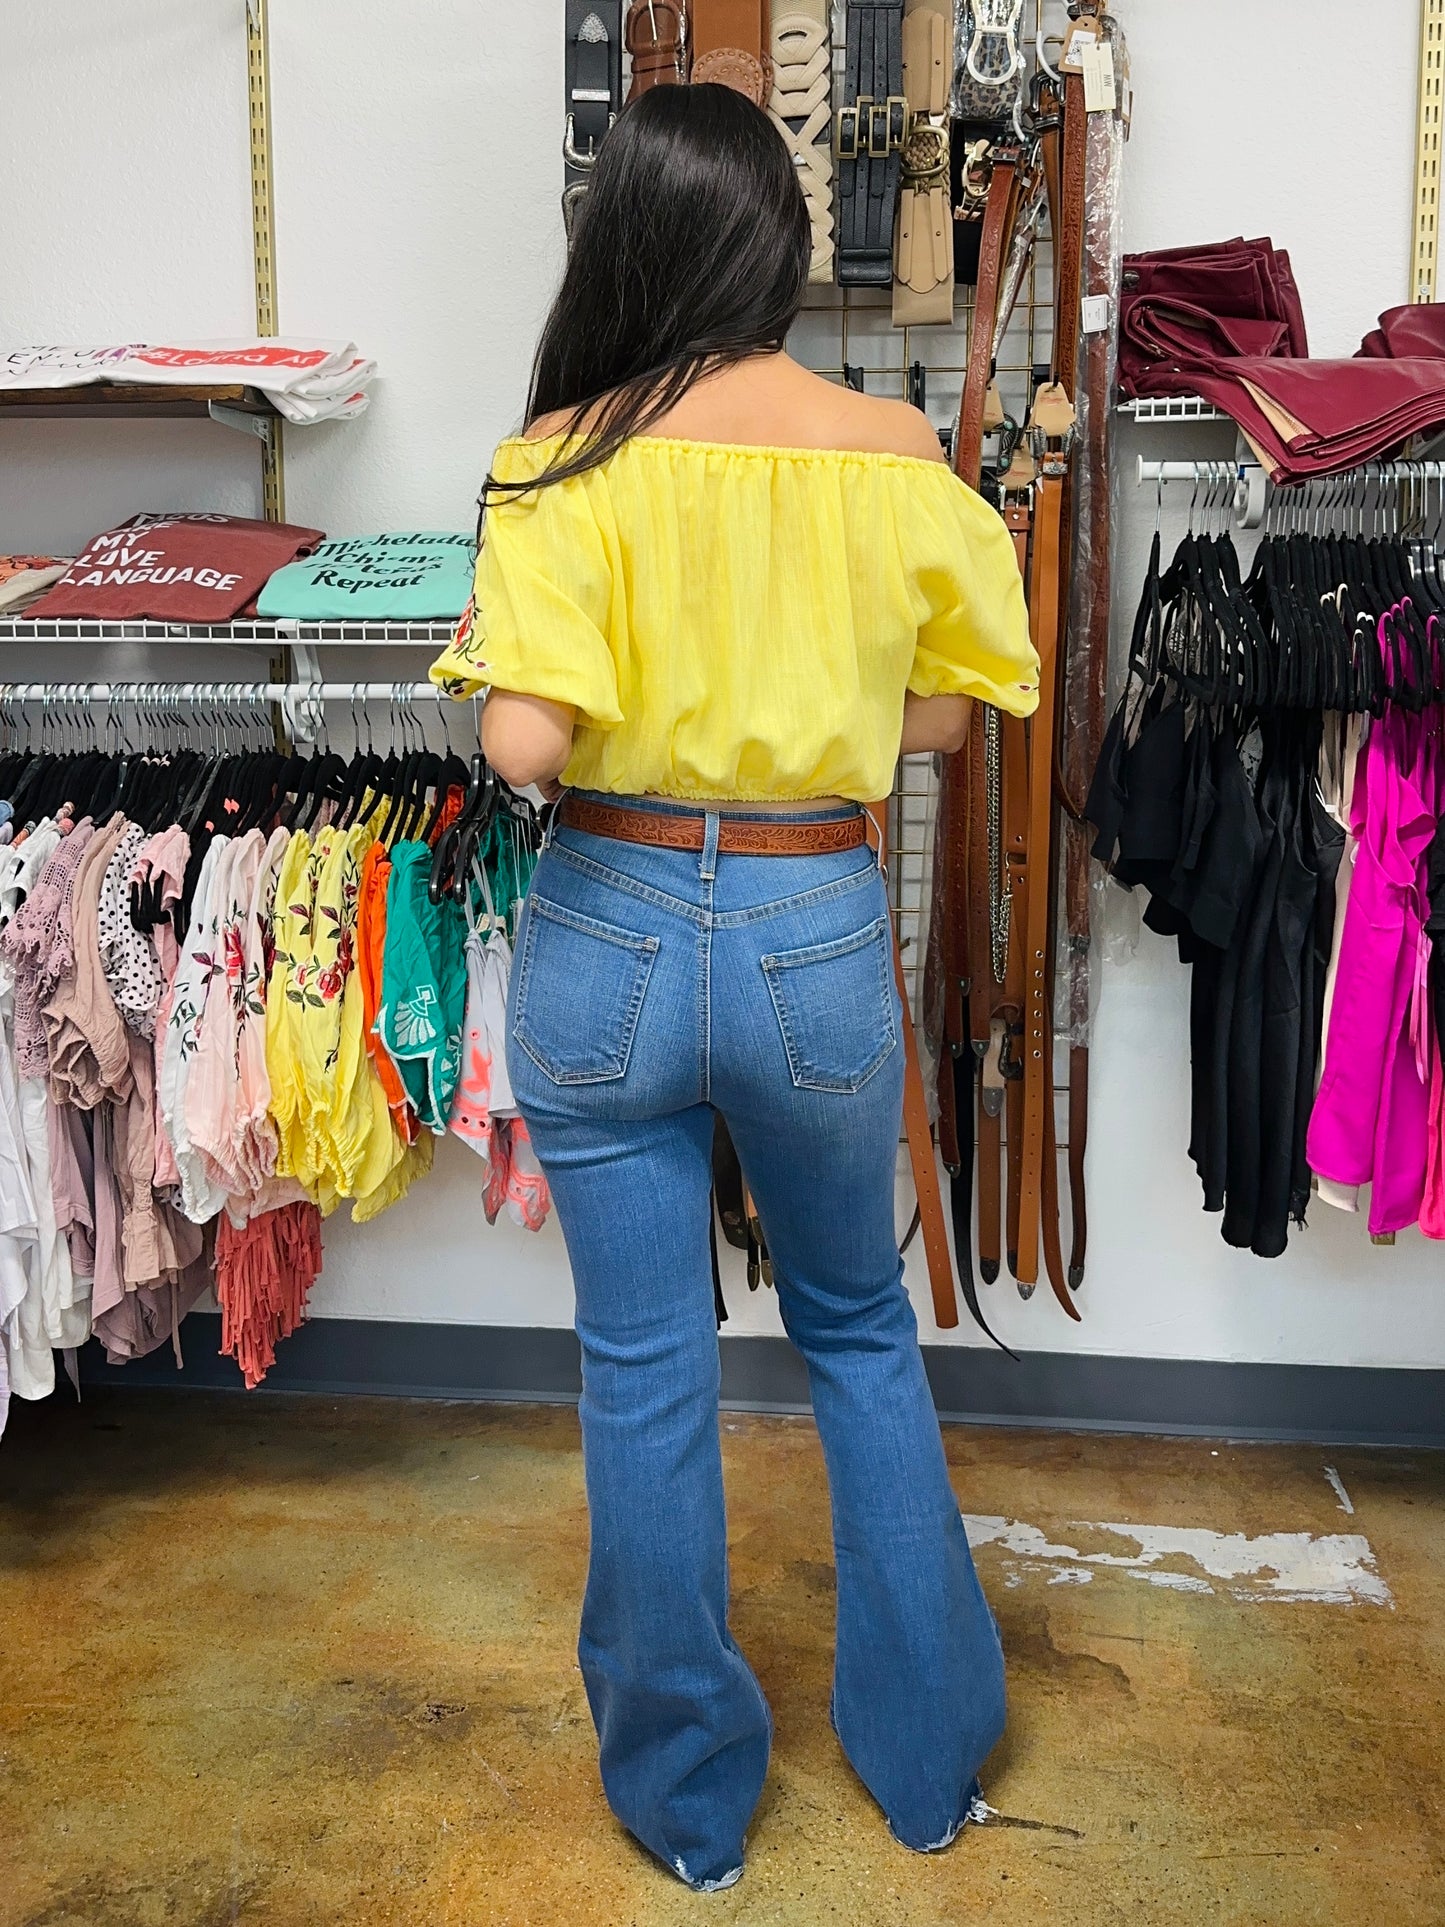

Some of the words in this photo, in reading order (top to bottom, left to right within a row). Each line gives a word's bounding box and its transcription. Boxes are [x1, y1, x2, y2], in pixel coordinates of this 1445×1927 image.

[91, 531, 150, 552] MY
[74, 547, 166, 568] LOVE
[58, 566, 244, 591] LANGUAGE
[310, 569, 426, 594] Repeat
